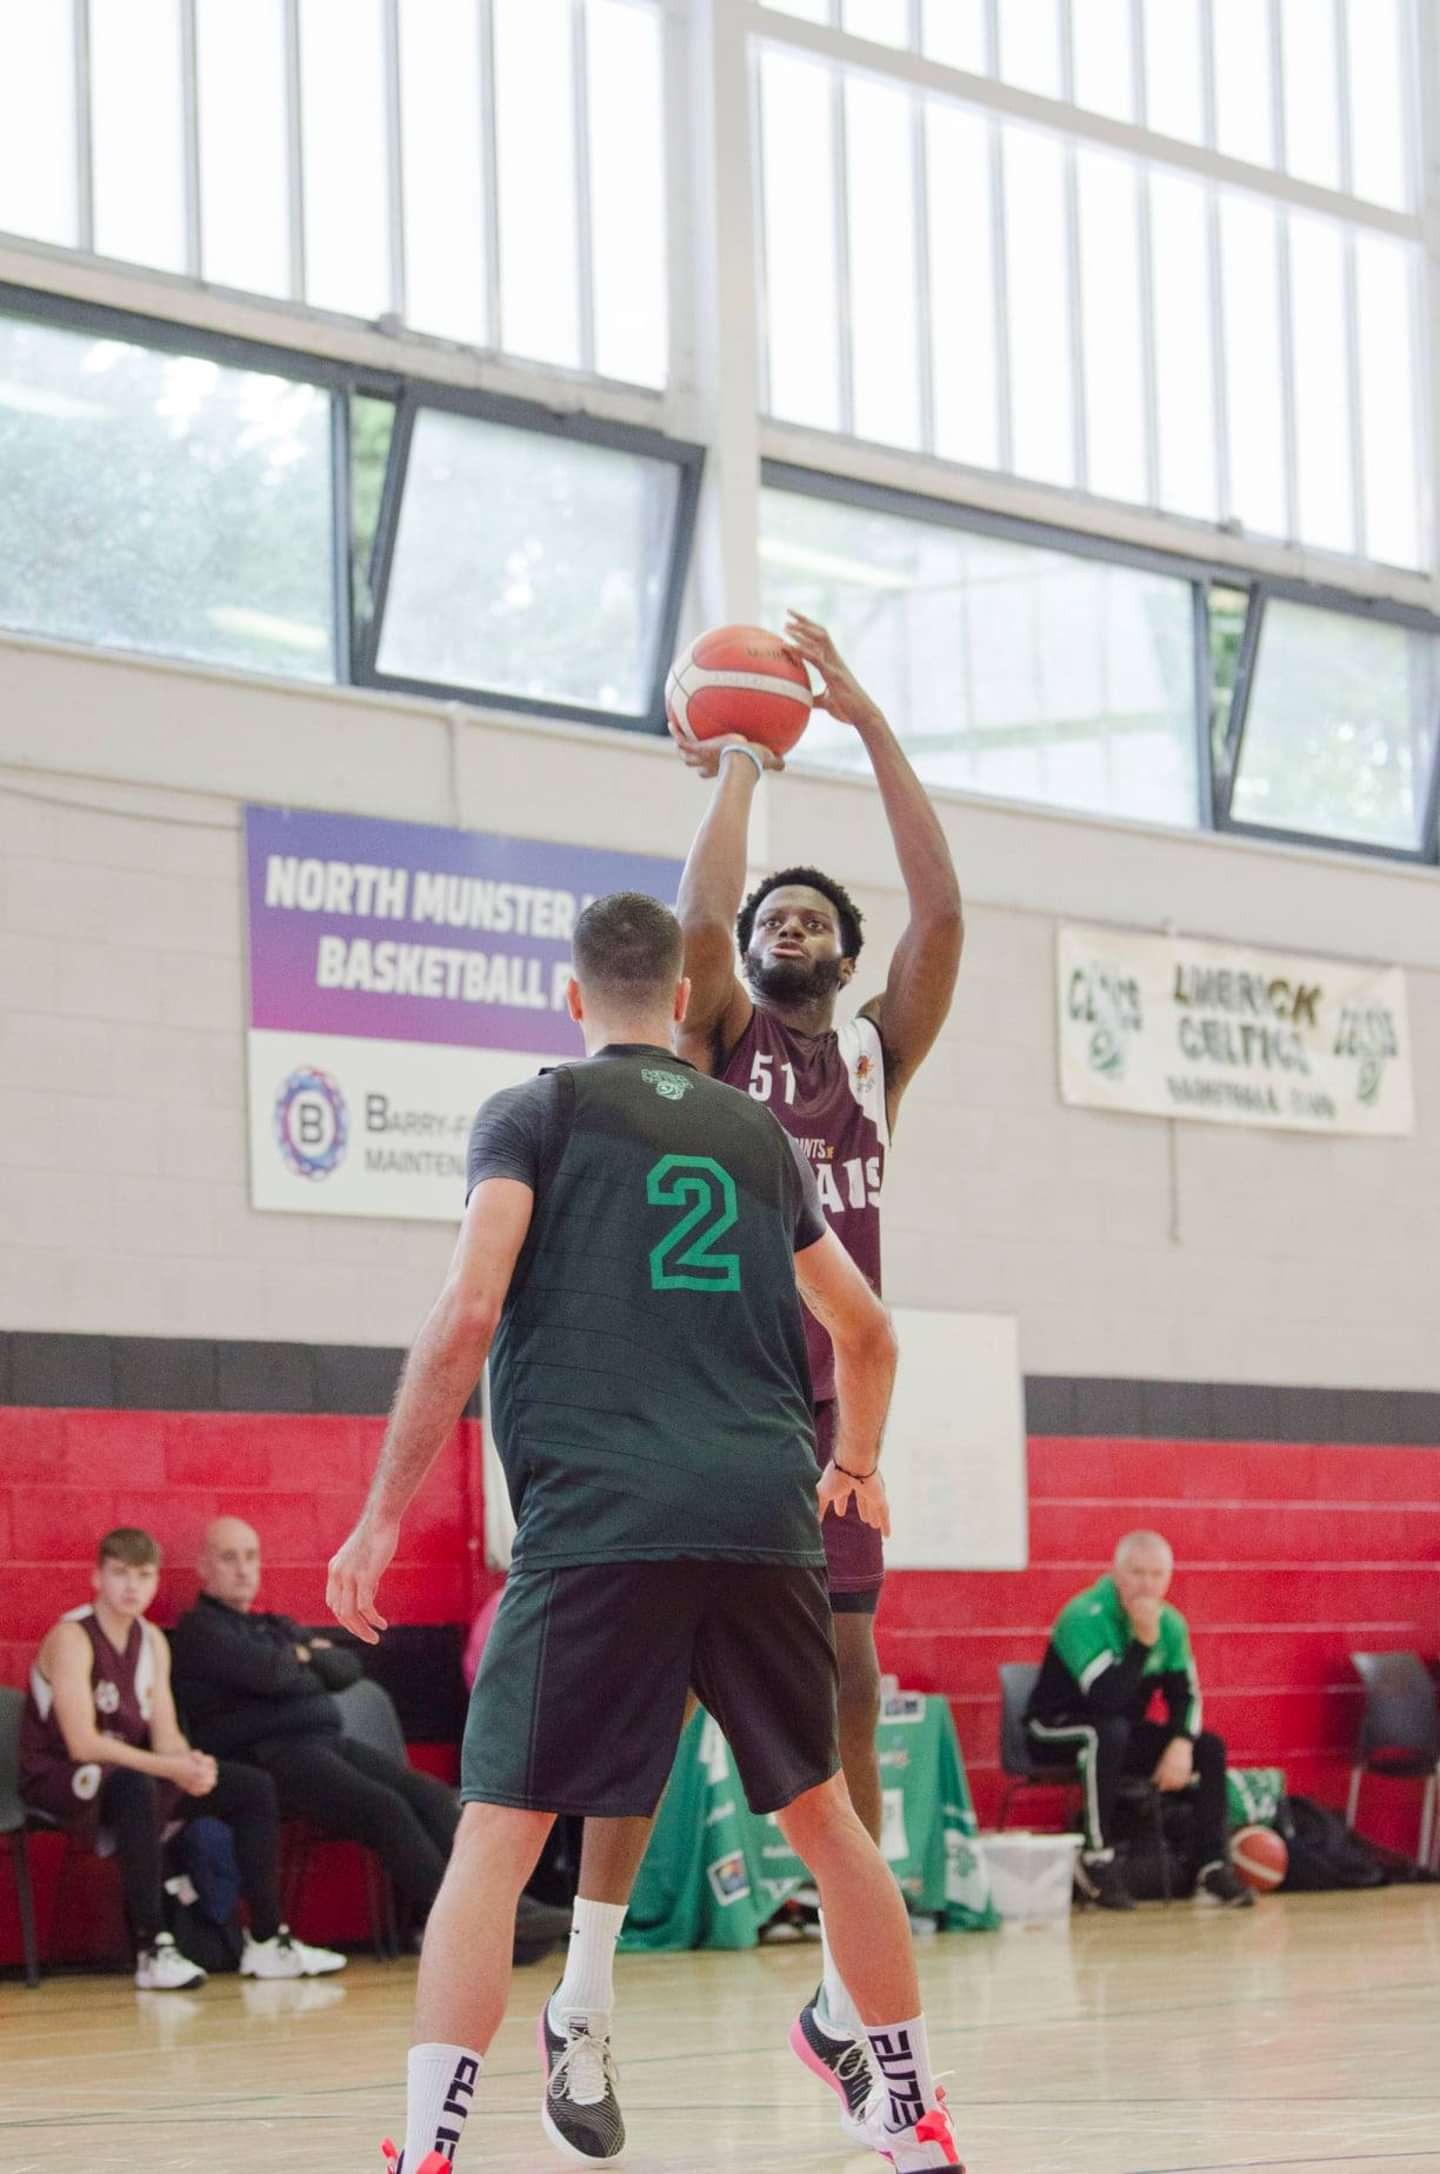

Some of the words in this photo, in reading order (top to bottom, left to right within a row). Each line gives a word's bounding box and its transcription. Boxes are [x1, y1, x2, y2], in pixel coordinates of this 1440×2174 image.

[264, 854, 410, 920] NORTH
[412, 871, 576, 940] MUNSTER
[316, 936, 548, 1009] BASKETBALL
[749, 1050, 796, 1105] 51
[300, 1103, 323, 1143] B
[646, 1154, 742, 1292] 2
